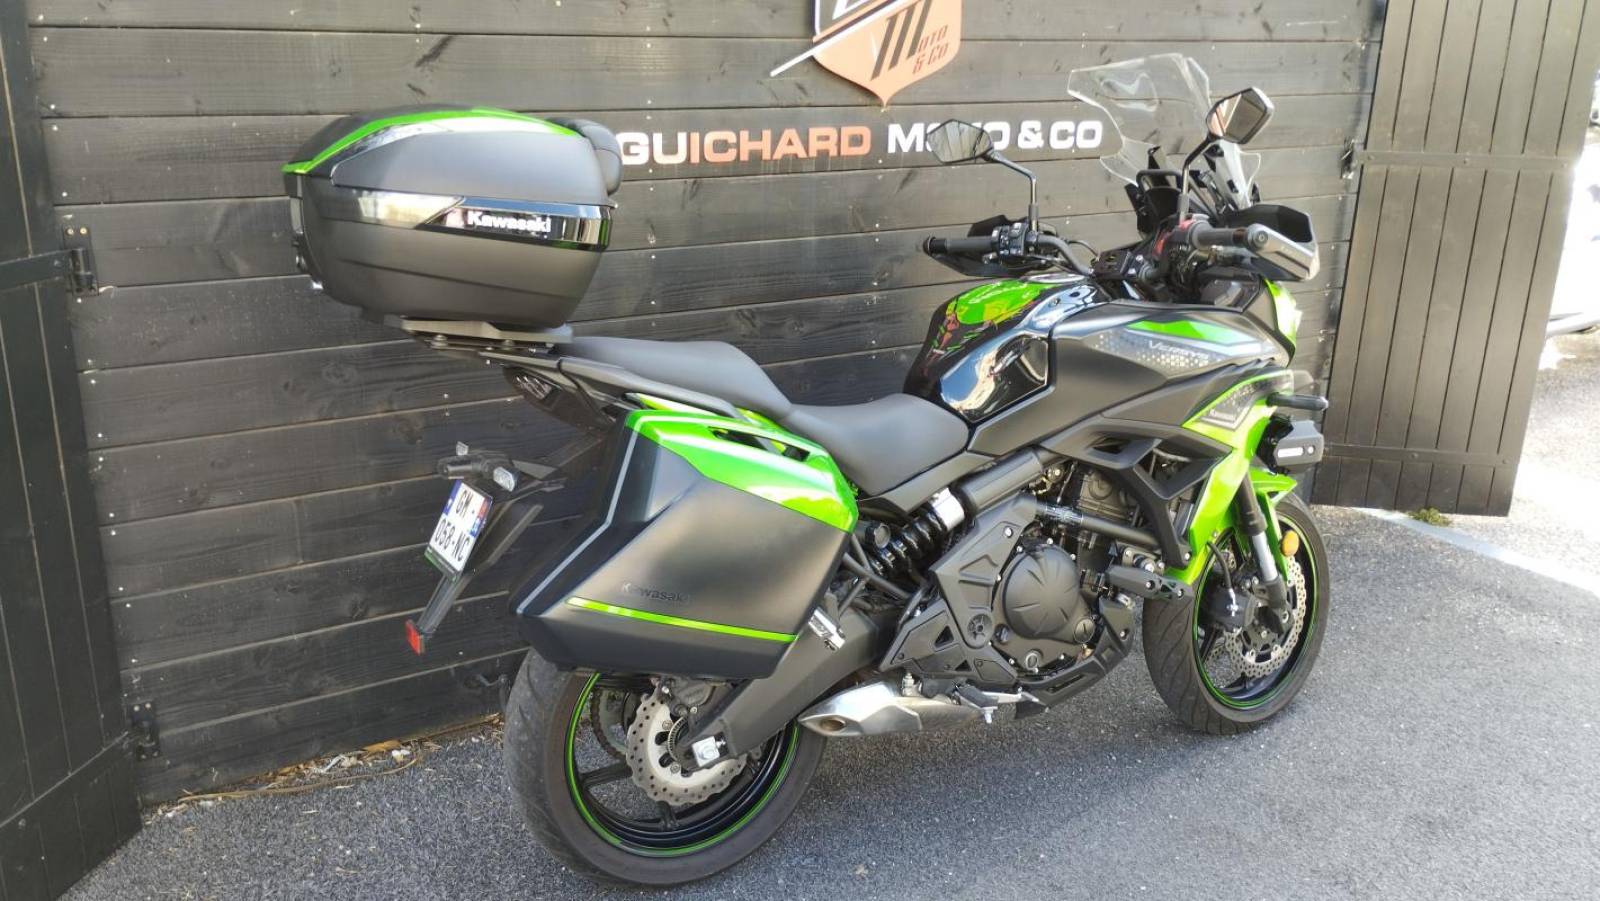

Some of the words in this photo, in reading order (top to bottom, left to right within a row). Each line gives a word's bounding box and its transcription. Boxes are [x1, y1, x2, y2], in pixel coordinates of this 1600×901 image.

[615, 126, 872, 165] GUICHARD
[1049, 120, 1103, 149] CO
[467, 210, 551, 233] Kawasaki
